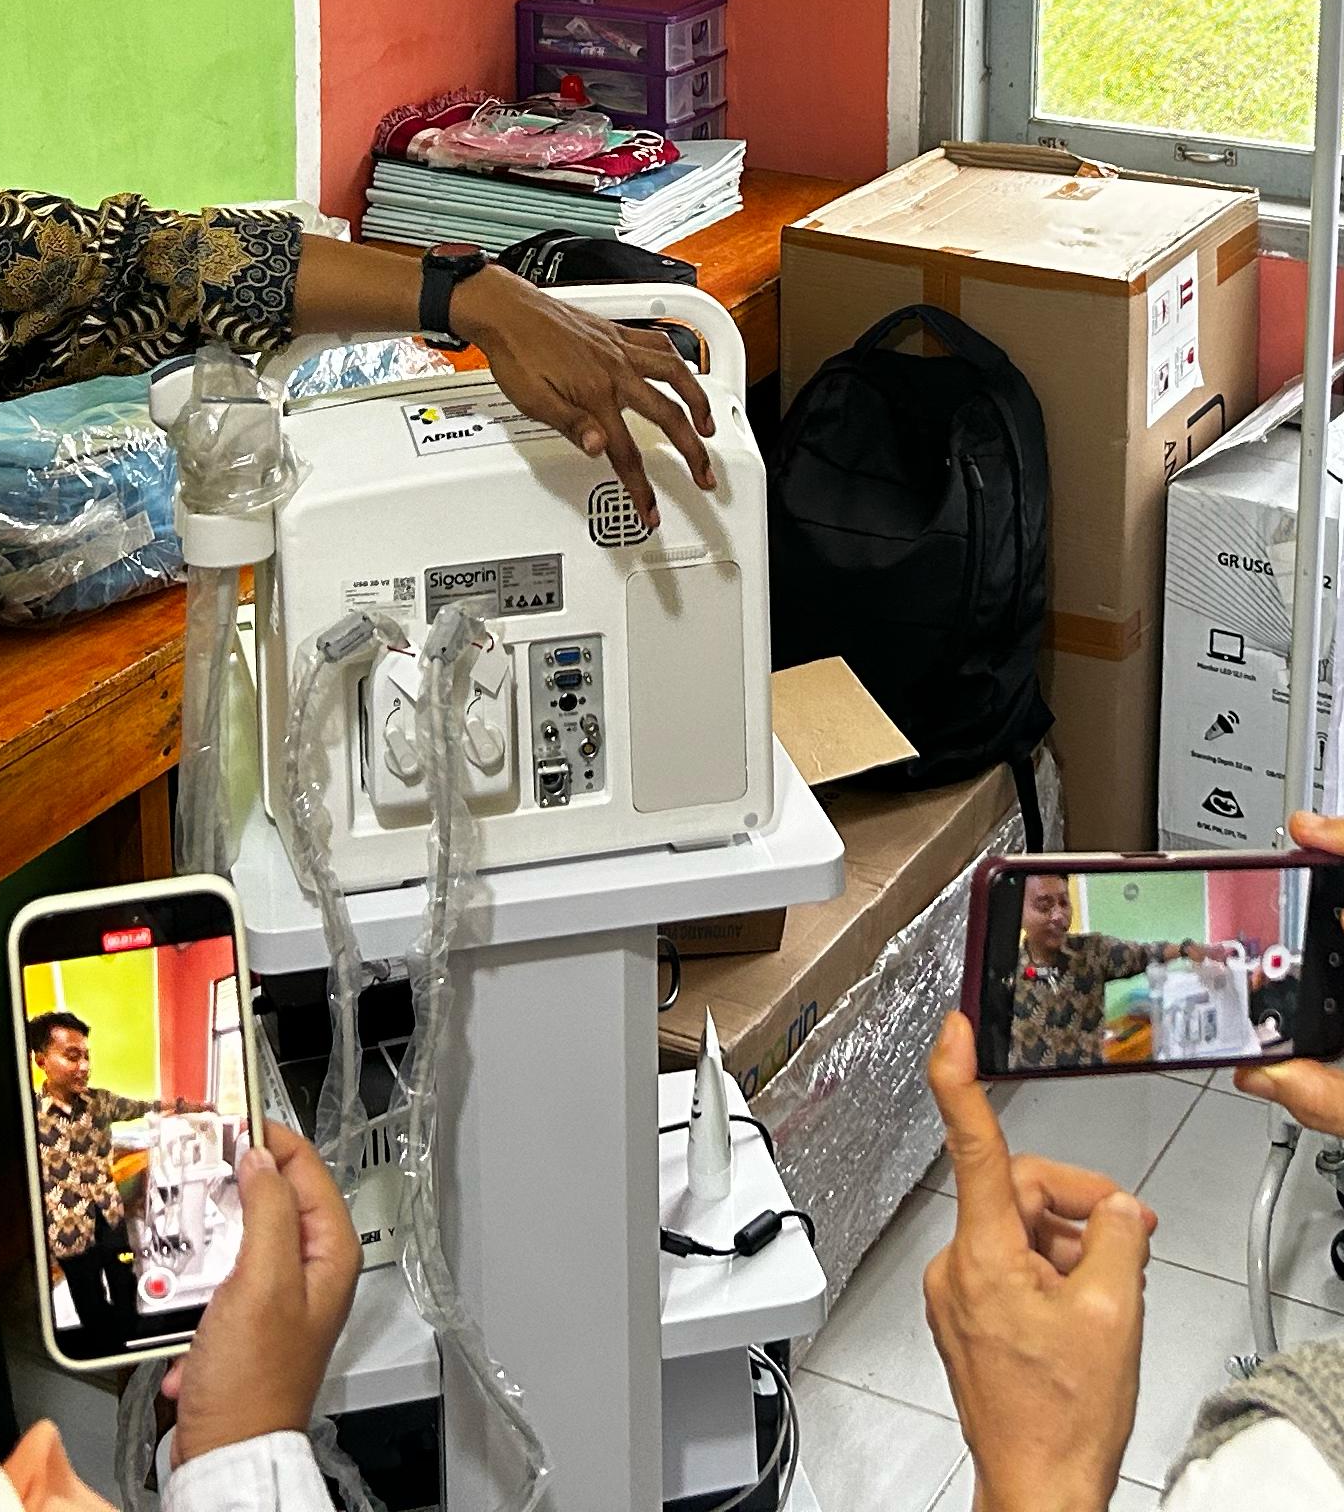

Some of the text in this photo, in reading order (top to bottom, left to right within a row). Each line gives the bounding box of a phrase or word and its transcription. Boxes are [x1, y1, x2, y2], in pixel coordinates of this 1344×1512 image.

[421, 428, 475, 445] APRIL
[1217, 551, 1239, 569] GR
[1242, 556, 1274, 576] USG
